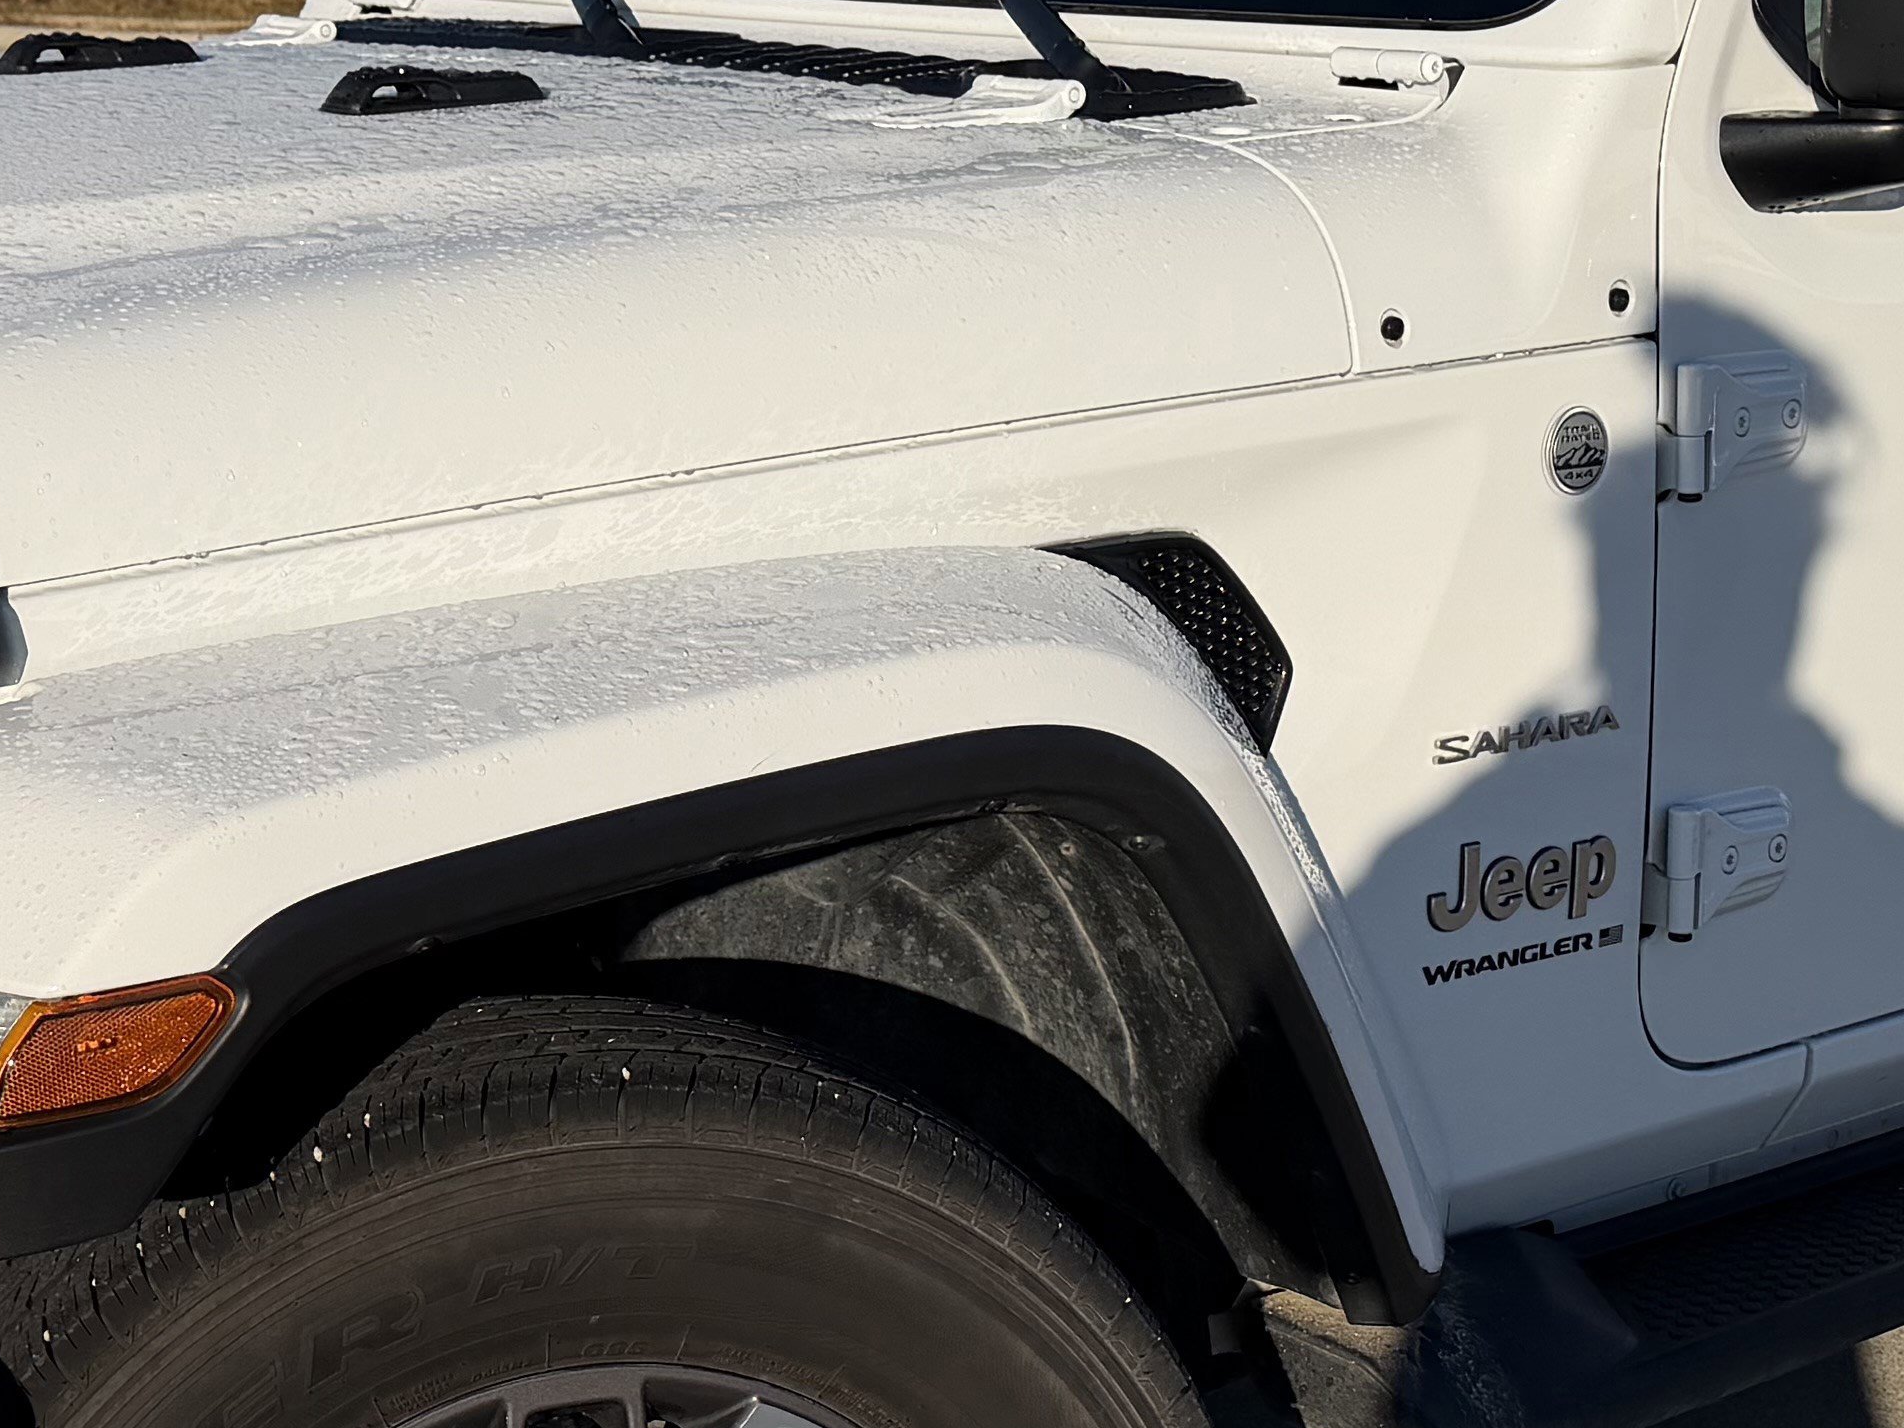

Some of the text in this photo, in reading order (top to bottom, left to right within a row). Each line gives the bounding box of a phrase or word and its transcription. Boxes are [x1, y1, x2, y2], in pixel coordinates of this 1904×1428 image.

[1432, 705, 1620, 765] SAHARA
[1427, 834, 1617, 933] Jeep
[1422, 932, 1593, 986] WRANGLER
